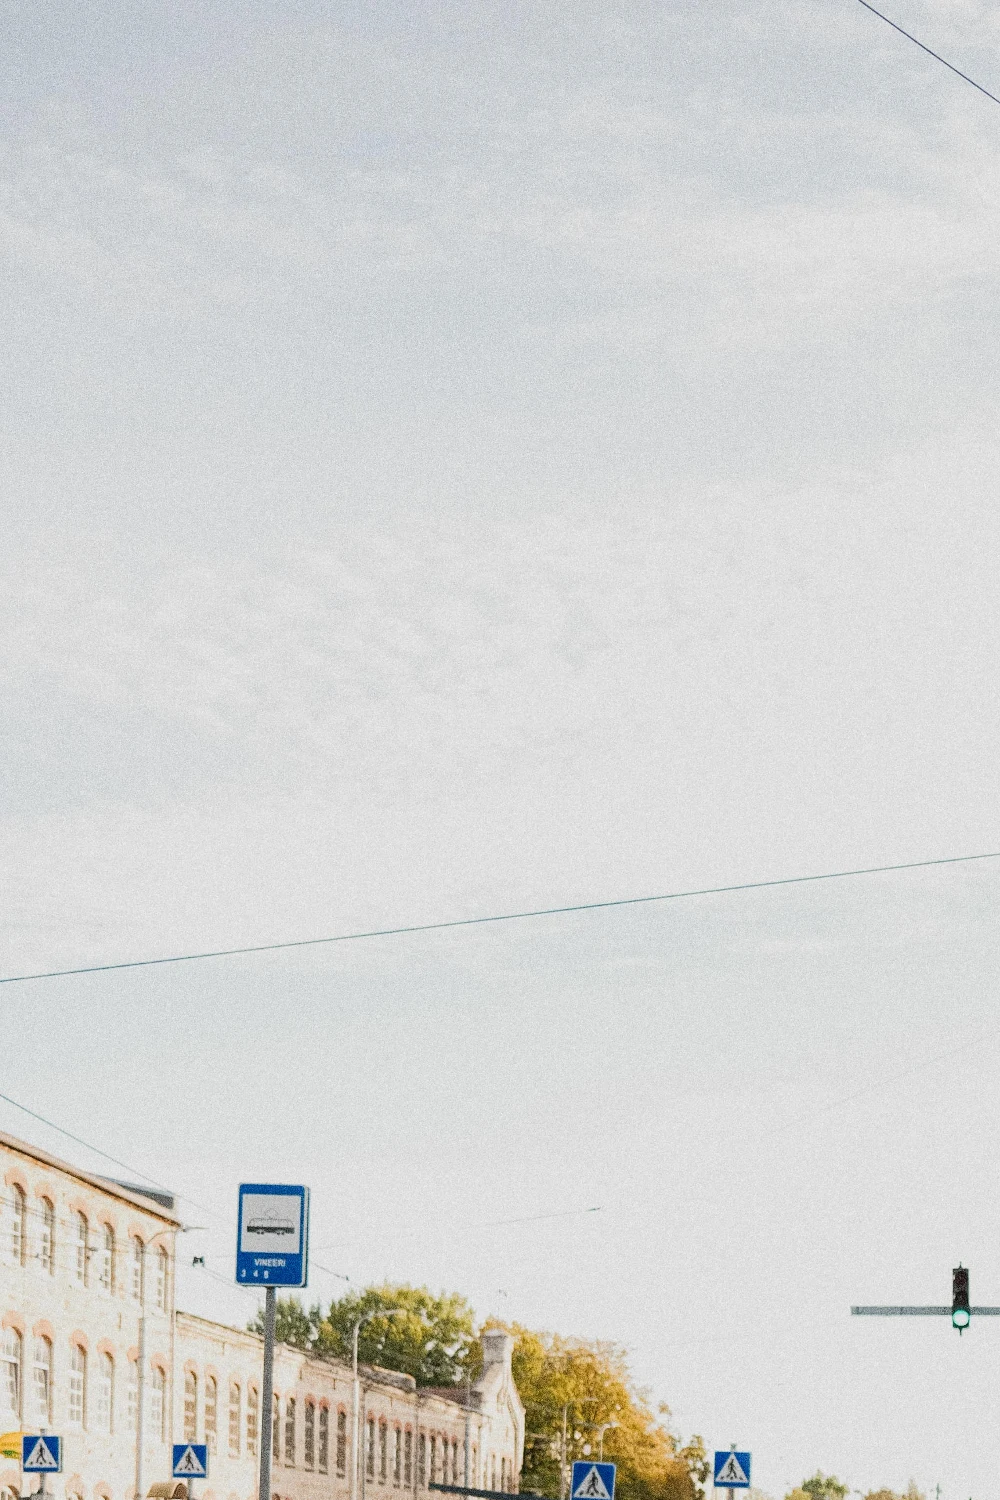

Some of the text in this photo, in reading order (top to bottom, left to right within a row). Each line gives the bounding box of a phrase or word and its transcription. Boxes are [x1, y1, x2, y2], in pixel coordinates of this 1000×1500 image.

[254, 1258, 286, 1267] VINEERI
[240, 1269, 246, 1278] 3
[253, 1269, 259, 1278] 4
